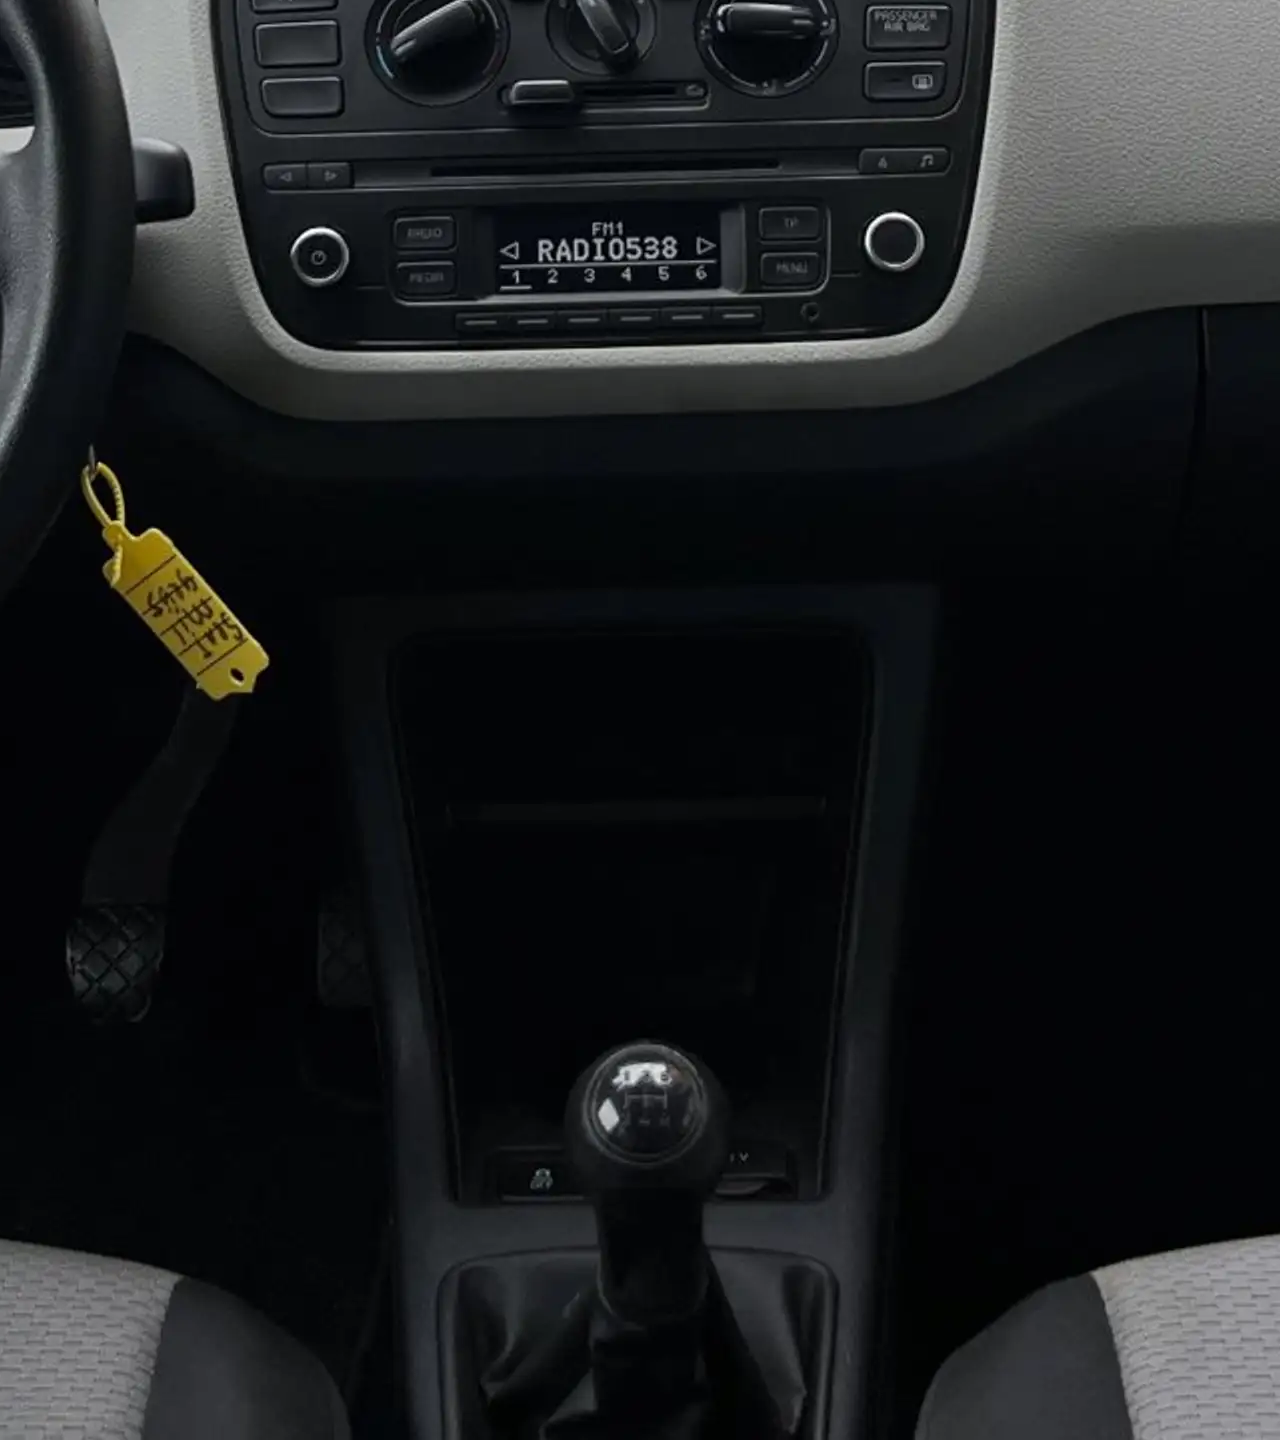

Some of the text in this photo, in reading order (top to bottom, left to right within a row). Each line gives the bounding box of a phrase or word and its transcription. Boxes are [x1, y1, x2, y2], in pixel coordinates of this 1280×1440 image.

[591, 221, 624, 237] FM1
[512, 264, 707, 284] 1 2 3 4 5 6
